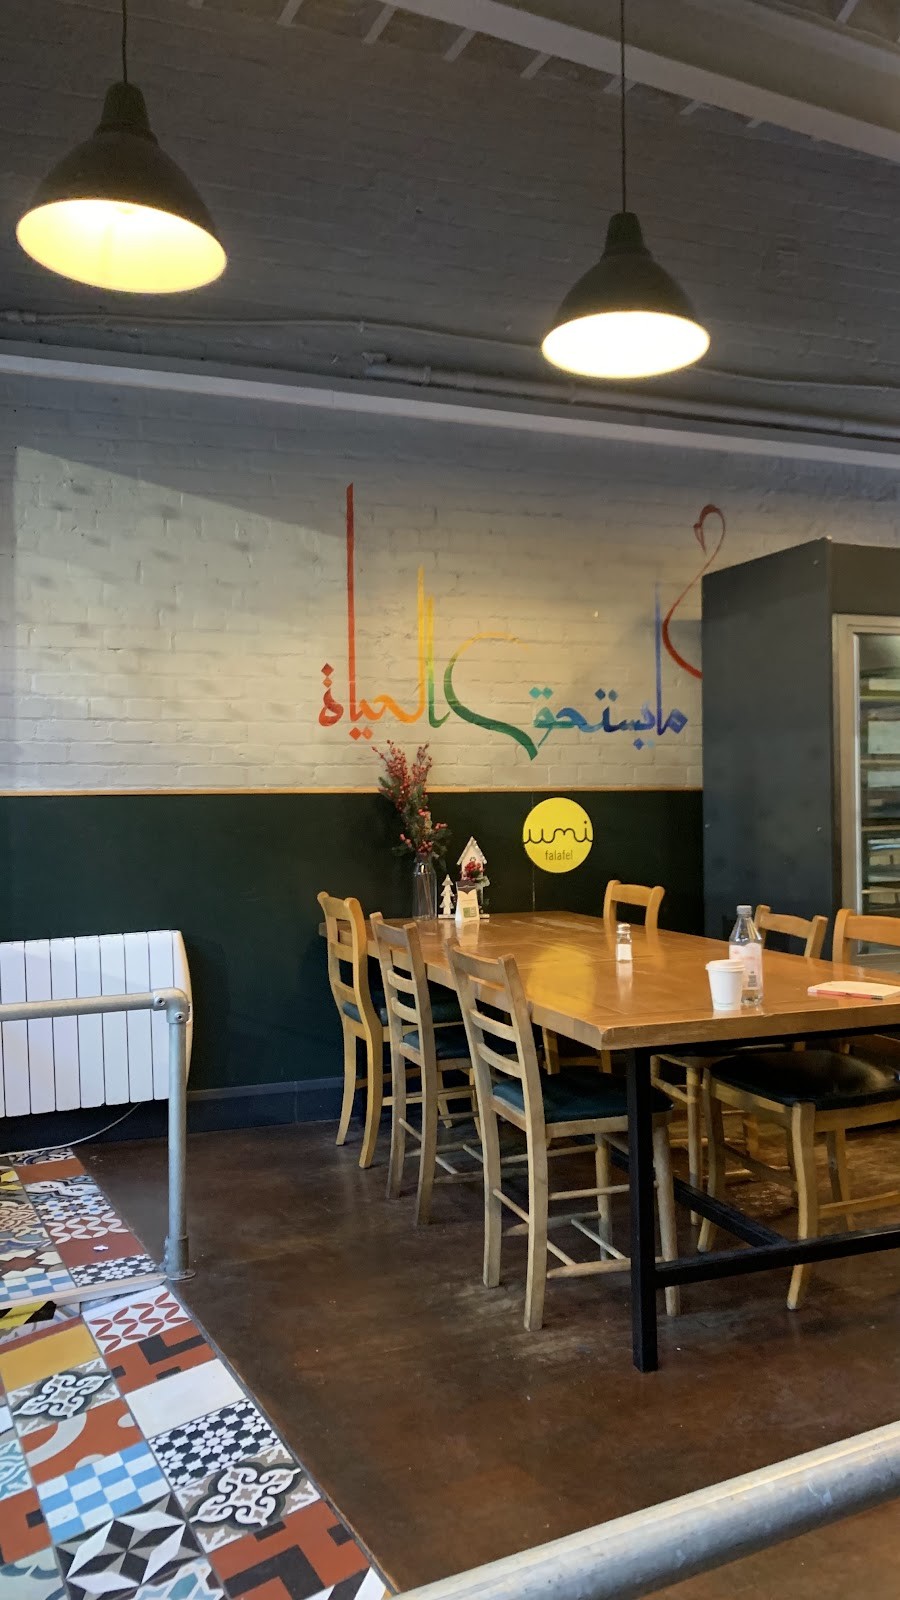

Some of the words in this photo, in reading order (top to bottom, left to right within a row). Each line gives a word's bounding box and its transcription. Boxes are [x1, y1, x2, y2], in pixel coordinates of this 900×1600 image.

[318, 482, 451, 741] الحياة
[523, 820, 593, 844] umi
[545, 850, 573, 861] falafel
